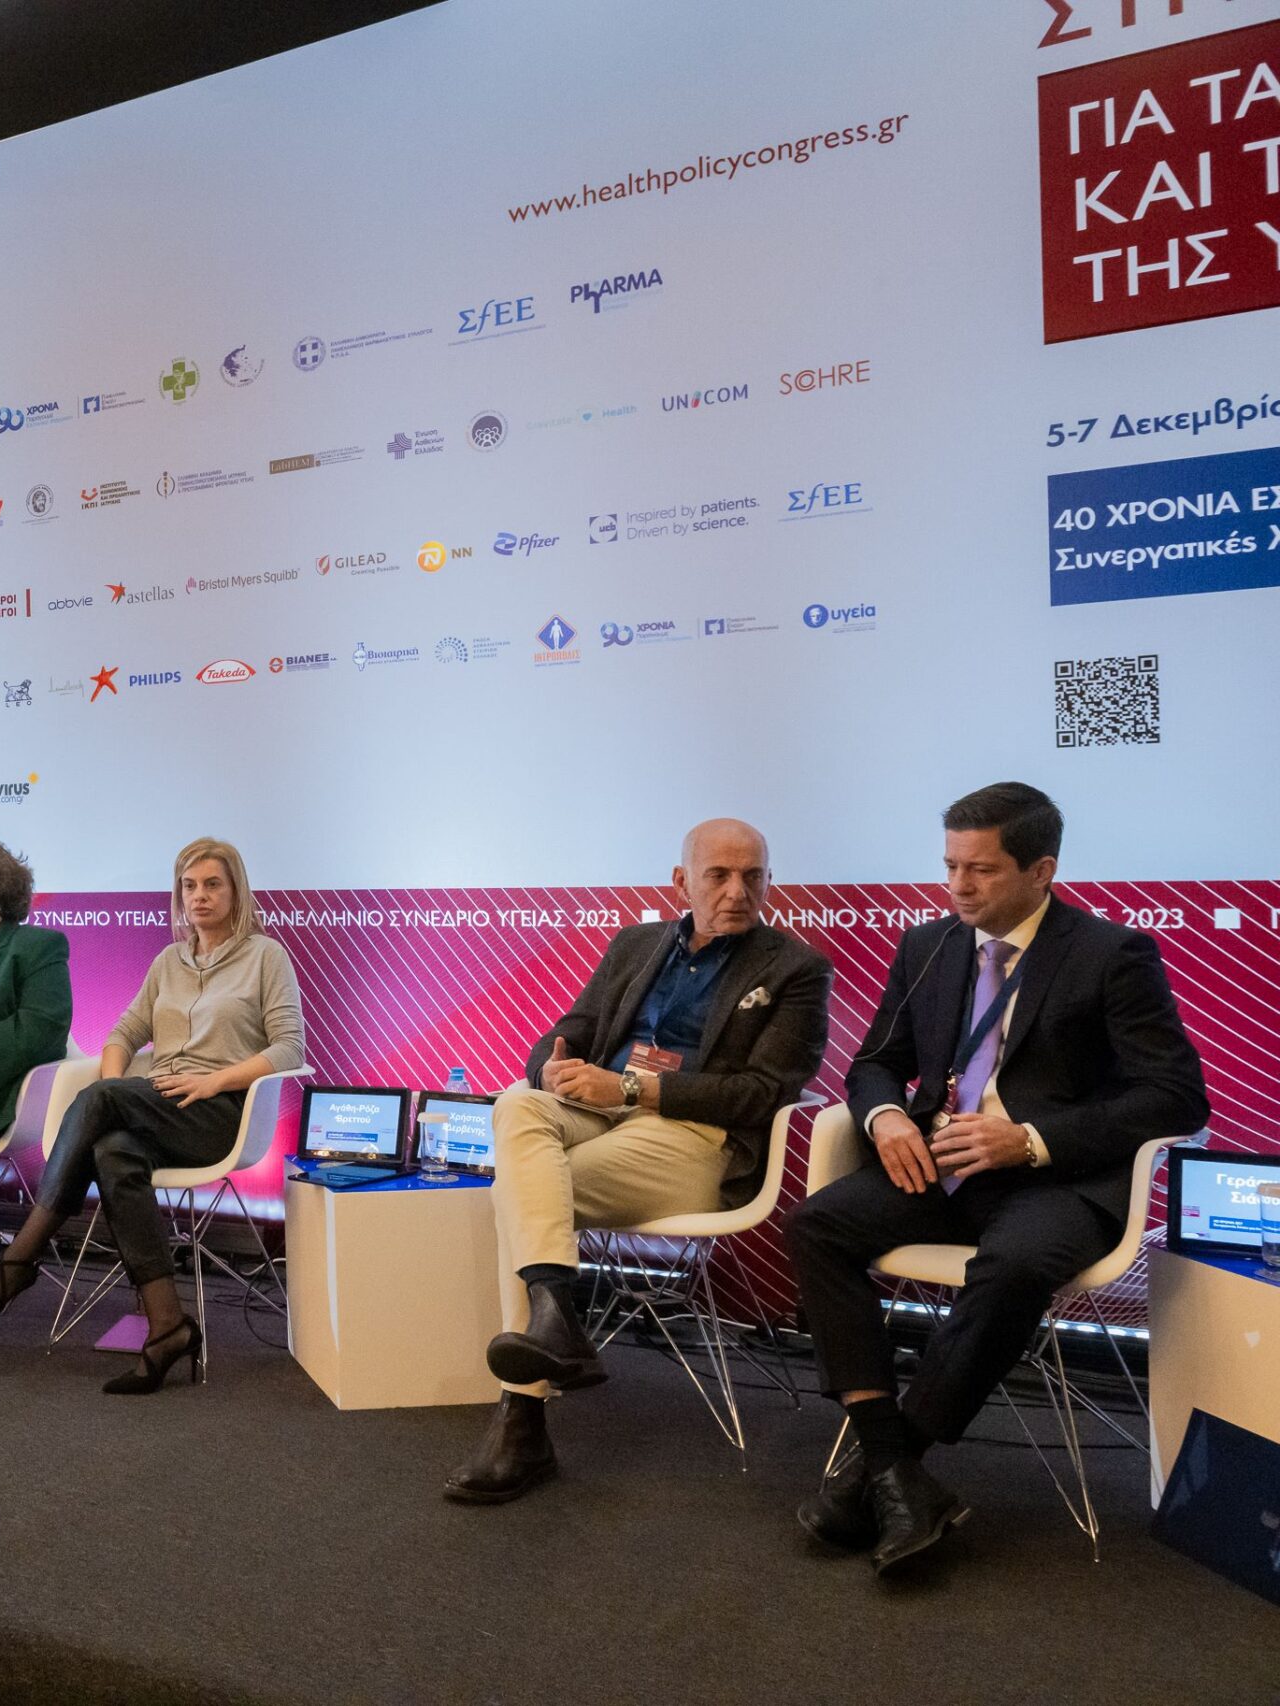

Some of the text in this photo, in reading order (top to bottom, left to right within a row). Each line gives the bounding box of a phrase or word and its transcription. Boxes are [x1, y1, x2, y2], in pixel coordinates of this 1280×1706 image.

[1069, 89, 1175, 155] ΓΙΑ
[508, 113, 909, 223] www.healthpolicycongress.gr
[1075, 151, 1212, 232] ΚΑΙ
[1073, 228, 1231, 302] ΤΗΣ
[1046, 417, 1099, 447] 5-7
[626, 496, 760, 524] Inspired by patients.
[1053, 506, 1096, 532] 40
[1106, 491, 1240, 527] ΧΡΟΝΙΑ
[627, 513, 749, 540] Driven by science.
[451, 547, 473, 559] NN
[518, 533, 560, 557] Pfizer
[1054, 530, 1258, 571] Συνεργατικές
[334, 552, 387, 570] GILEAD
[198, 569, 298, 592] Bristol Myers Squibb
[48, 595, 93, 611] abbvie
[126, 586, 175, 604] astellas
[830, 603, 876, 623] υγεία
[636, 620, 676, 632] ΧΡΟΝΙΑ
[129, 671, 182, 687] PHILIPS
[207, 667, 247, 679] Takeda
[33, 911, 168, 926] ΣΥΝΕΔΡΙΟ ΥΓΕΙΑΣ
[389, 910, 490, 927] ΣΥΝΕΔΡΙΟ
[497, 910, 566, 928] ΥΓΕΙΑΣ
[575, 909, 620, 928] 2023
[1122, 908, 1185, 929] 2023
[449, 1112, 486, 1123] Χρήστος
